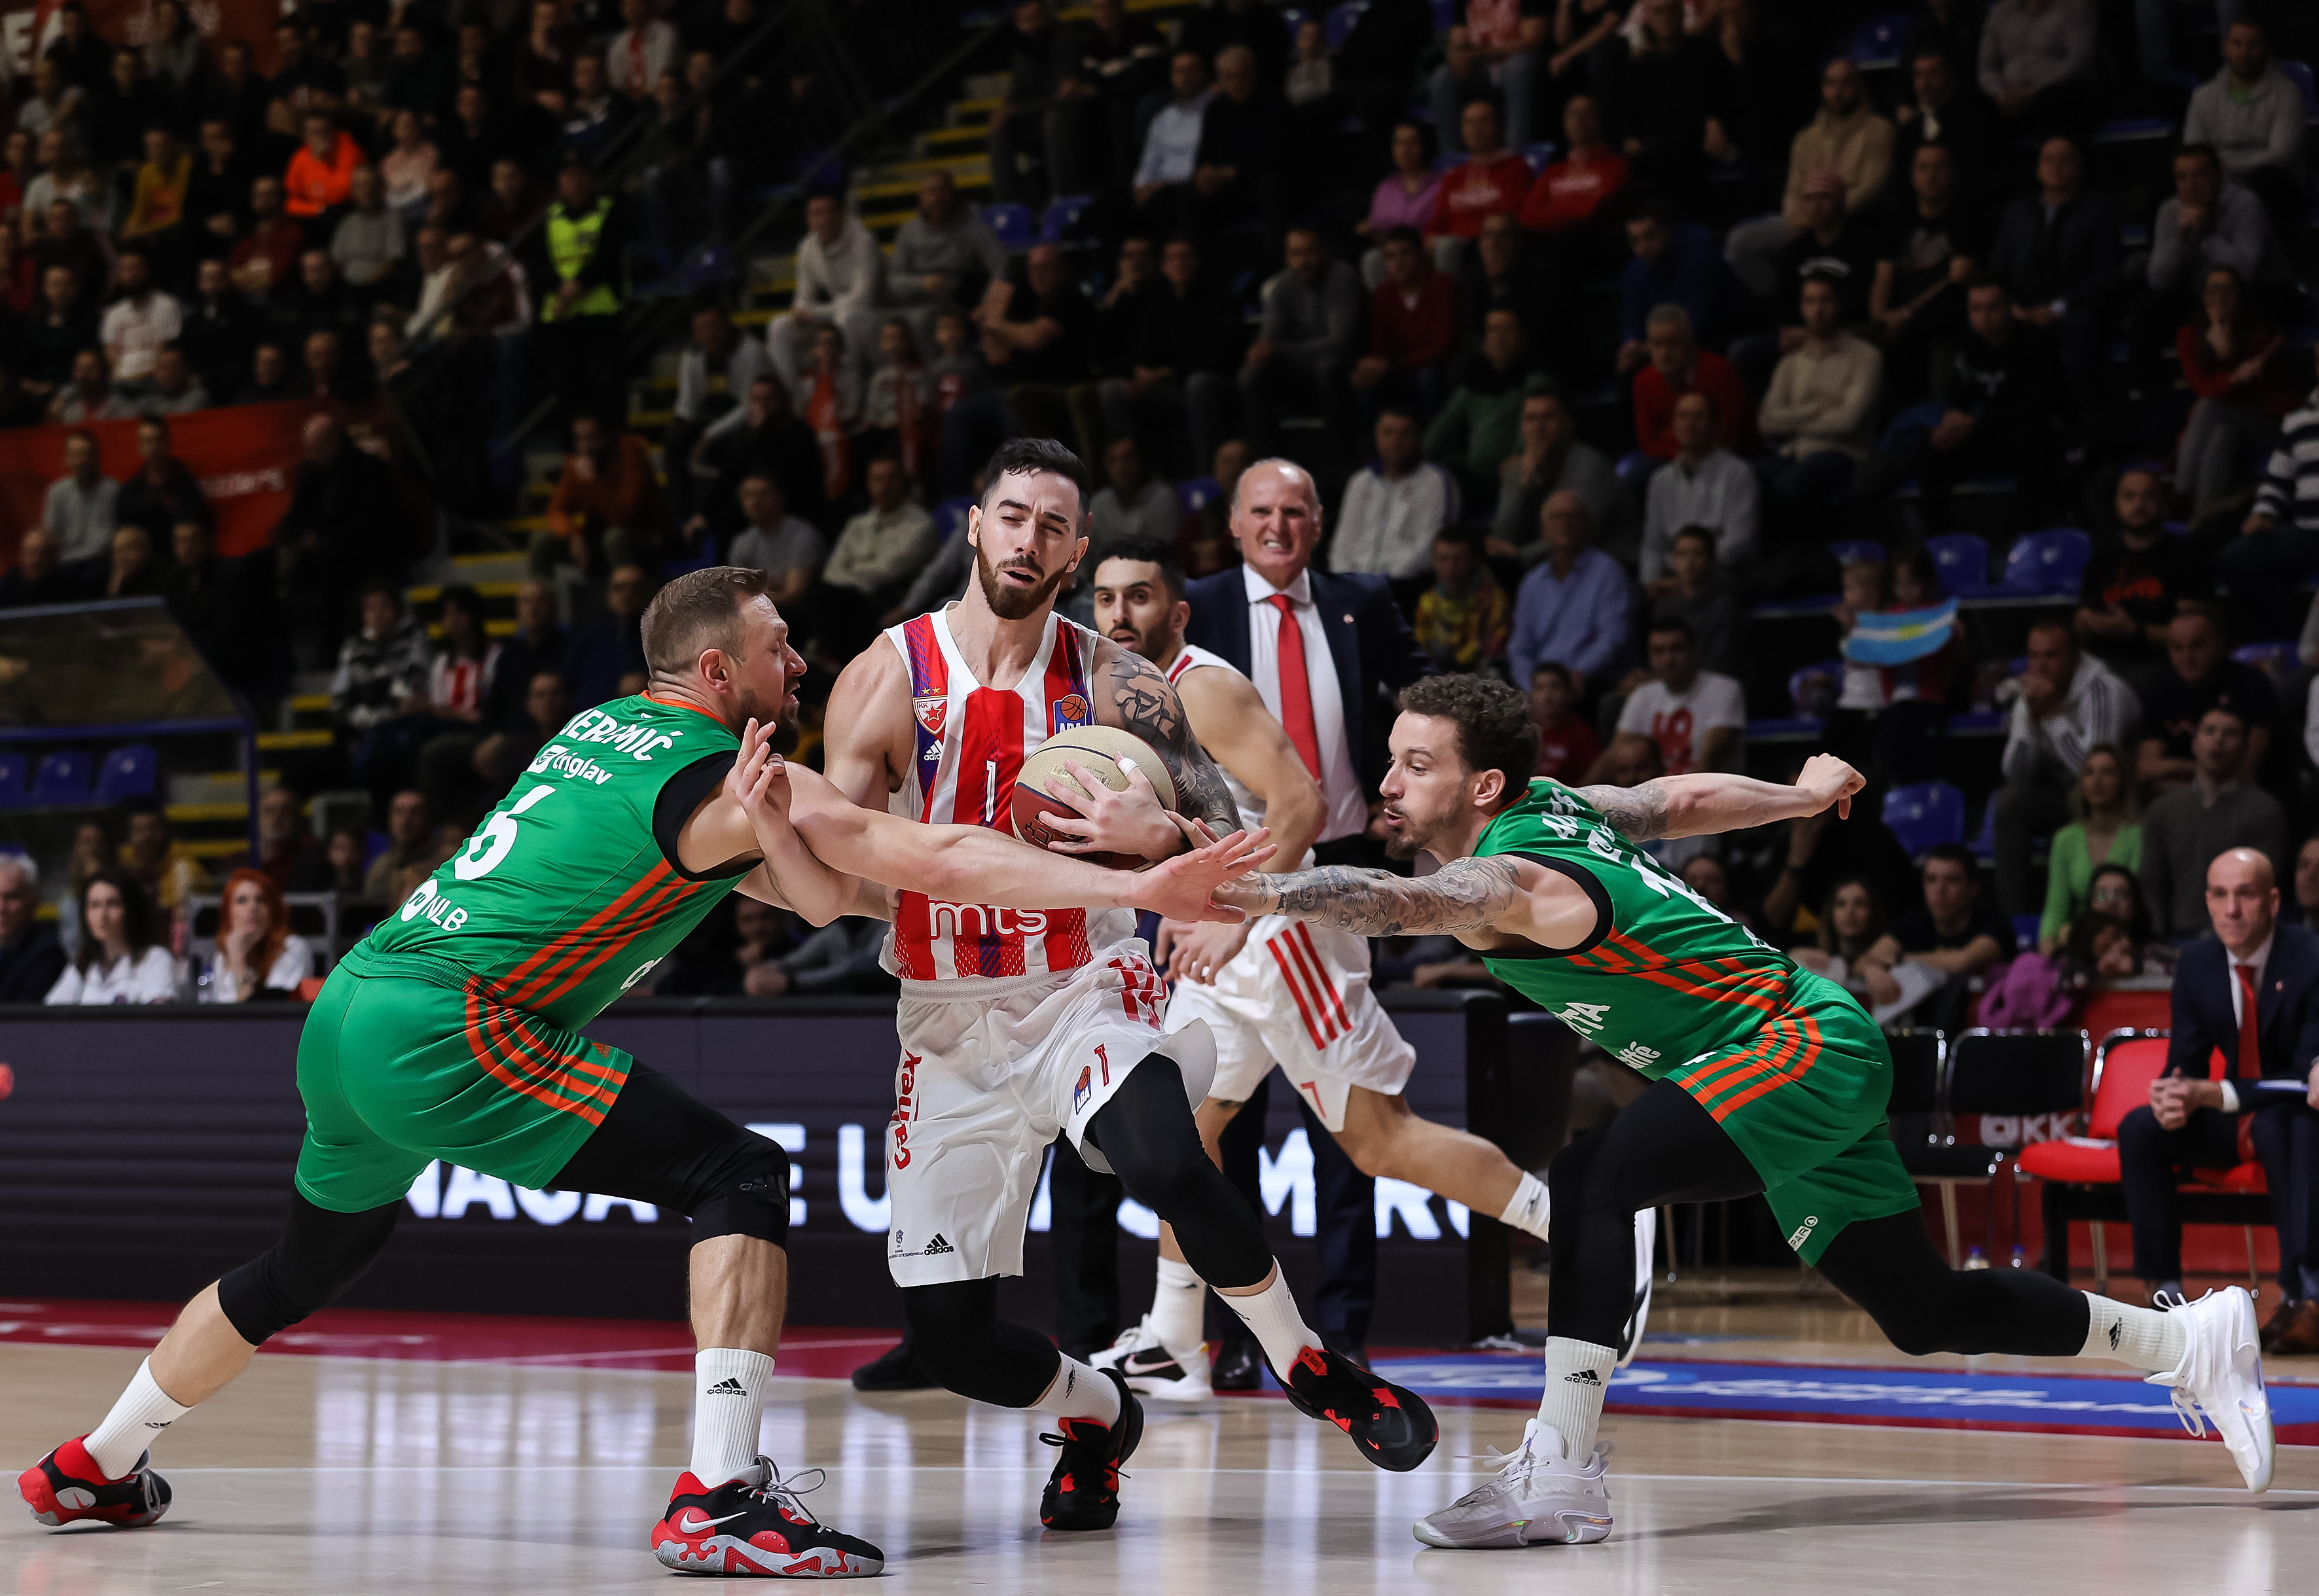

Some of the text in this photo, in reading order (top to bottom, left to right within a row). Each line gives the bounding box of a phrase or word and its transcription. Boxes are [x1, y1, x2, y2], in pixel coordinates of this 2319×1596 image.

[559, 708, 684, 761] JERMIĆ
[552, 751, 613, 785] triglav
[986, 760, 997, 823] 1
[454, 785, 556, 881] 6
[420, 895, 469, 932] NLB
[929, 902, 1047, 936] mts
[1094, 1042, 1109, 1087] 1
[1076, 1086, 1090, 1112] ABA
[1299, 1080, 1327, 1119] 7
[924, 1245, 954, 1256] adidas
[707, 1386, 747, 1396] adidas
[1564, 1374, 1602, 1387] adidas
